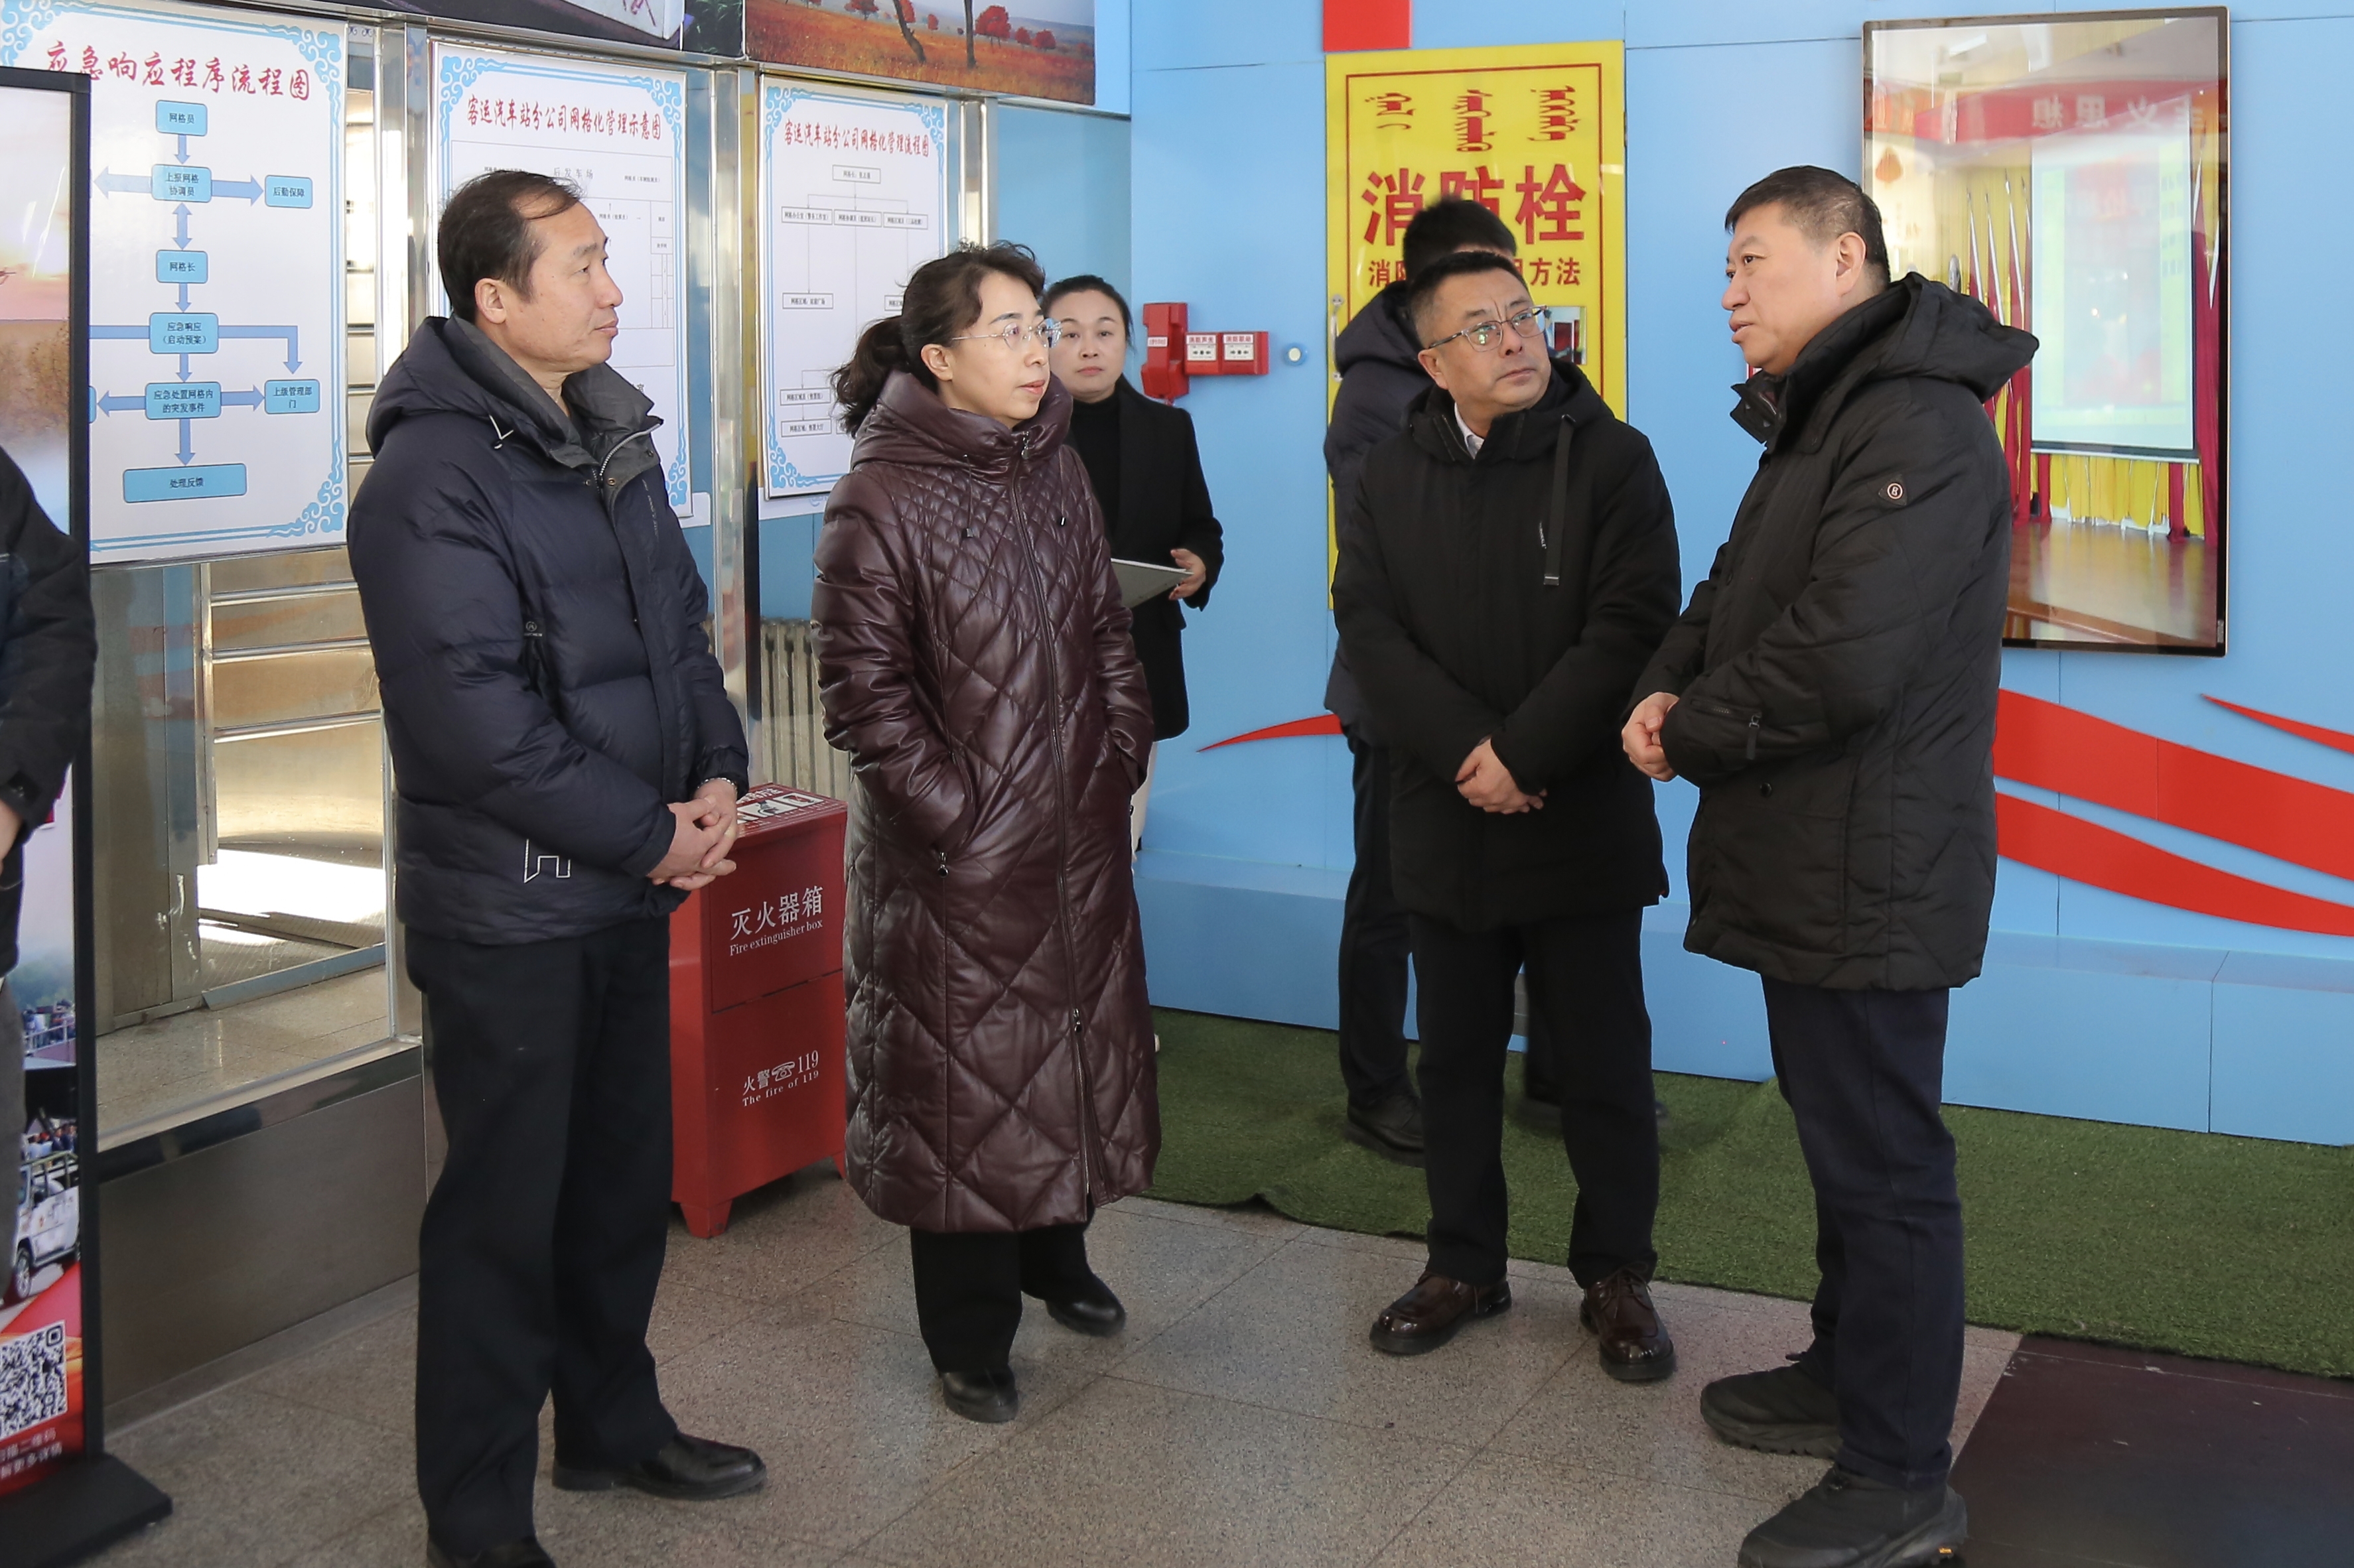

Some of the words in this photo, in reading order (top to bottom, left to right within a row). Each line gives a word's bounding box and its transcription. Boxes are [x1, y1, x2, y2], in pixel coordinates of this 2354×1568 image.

[47, 40, 310, 101] 应急响应程序流程图
[169, 113, 195, 124] 网格员
[467, 94, 661, 141] 客运汽车站分公司网格化管理示意图
[784, 119, 929, 157] 客运汽车站分公司网格化管理流程图
[165, 172, 200, 184] 上报网格
[169, 185, 195, 197] 协调员
[273, 187, 305, 198] 后勤保障
[169, 262, 196, 273] 网格长
[167, 322, 202, 332] 应急响应
[154, 389, 213, 400] 应急处置网格内
[273, 387, 312, 397] 上级管理部
[163, 403, 205, 413] 的突发事件
[289, 400, 297, 409] 门
[169, 478, 204, 488] 处理反馈
[730, 885, 823, 941] 灭火器箱
[730, 943, 748, 956] Fire
[750, 926, 805, 948] extinguisher
[806, 919, 823, 931] box
[742, 1069, 770, 1096] 火警
[797, 1049, 819, 1074] 119
[742, 1094, 761, 1107] The
[766, 1085, 784, 1098] fire
[788, 1078, 799, 1088] of
[803, 1070, 819, 1083] 119
